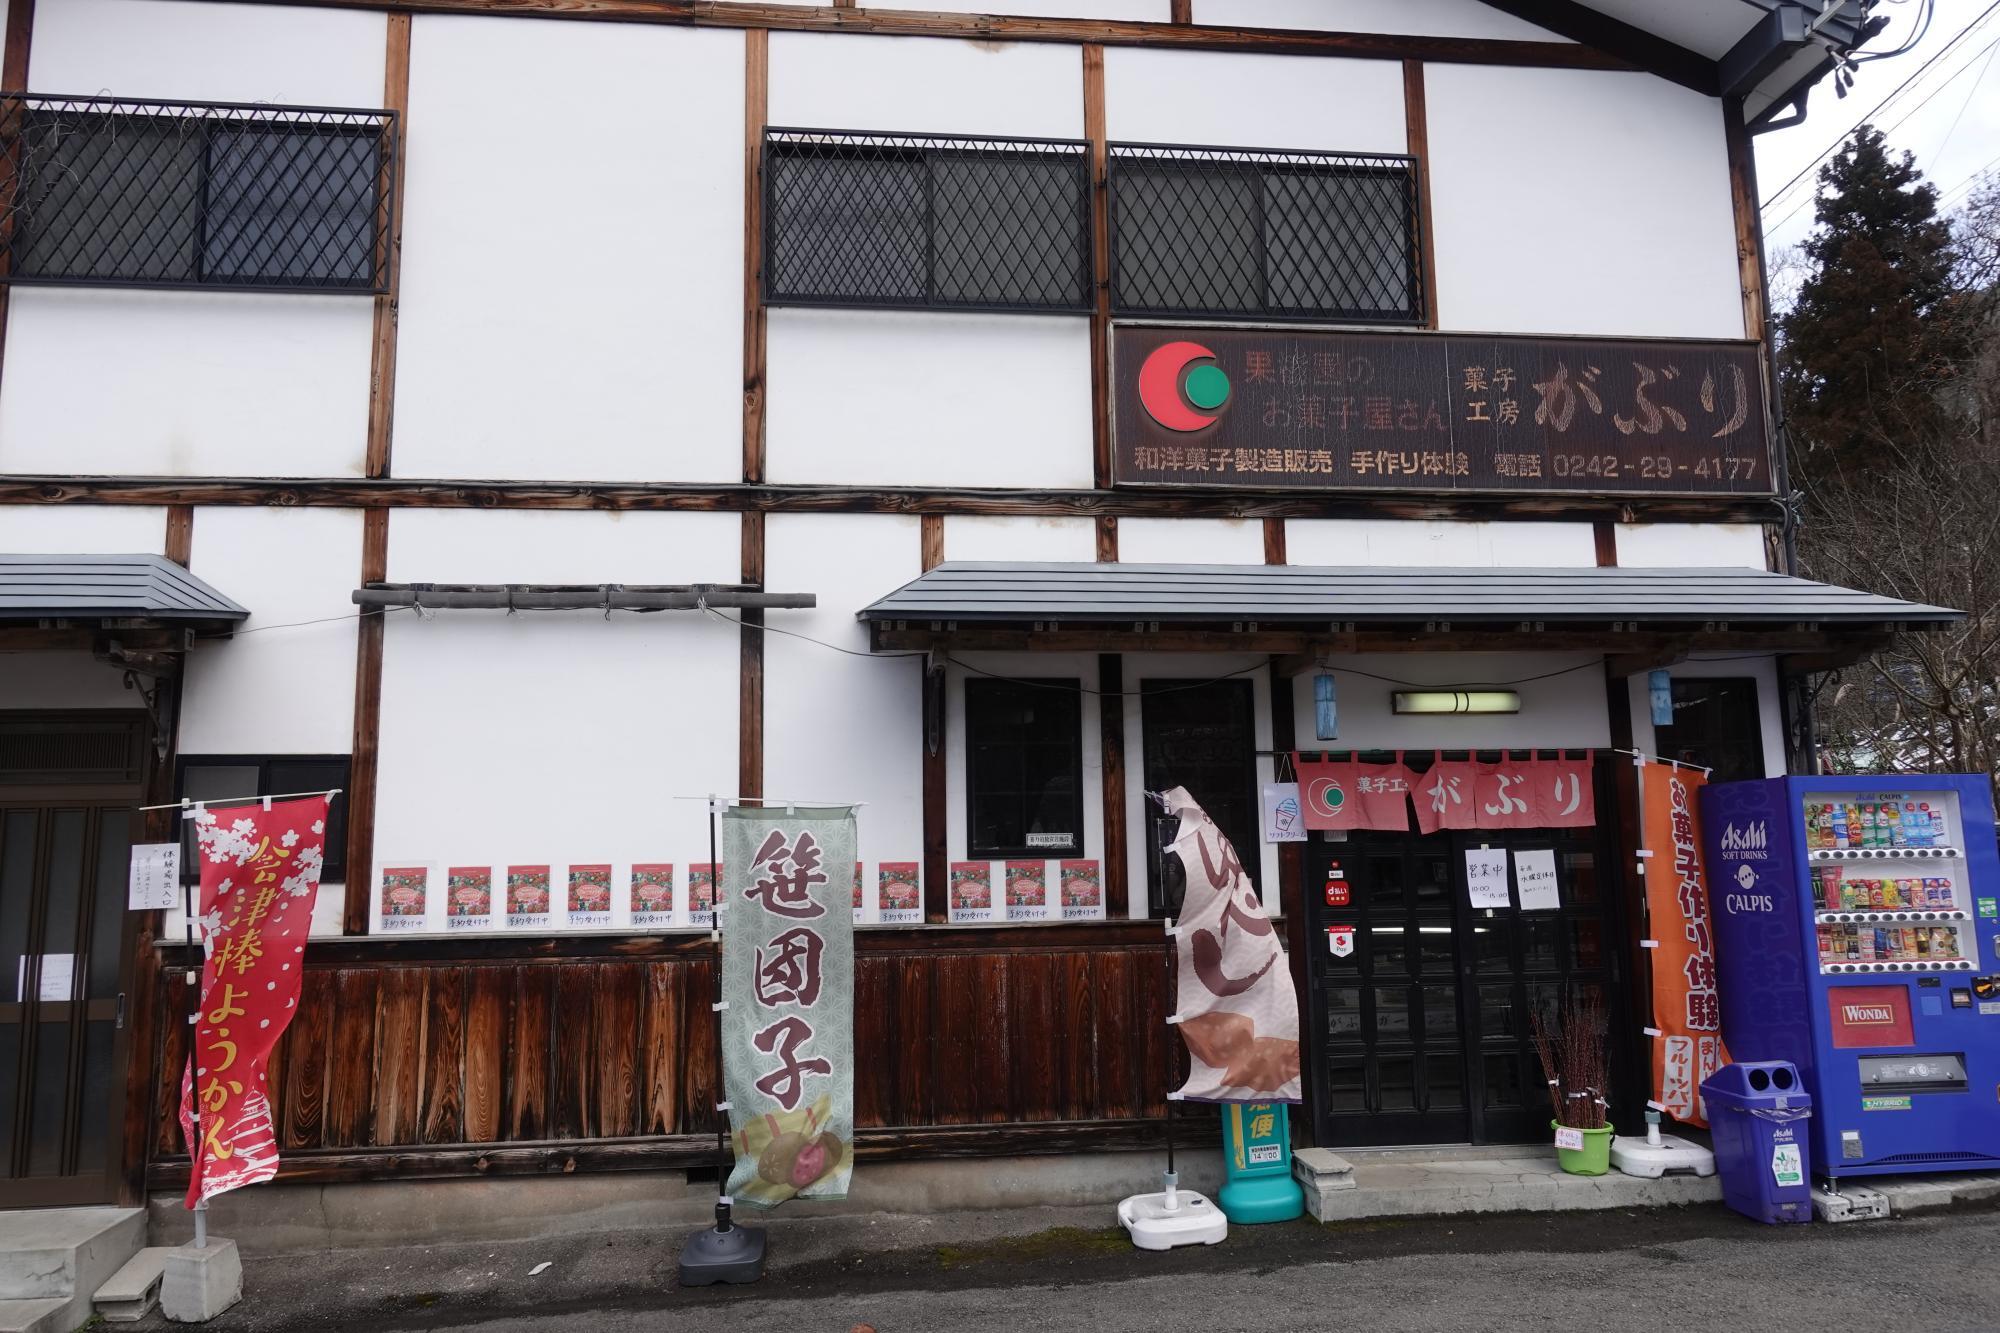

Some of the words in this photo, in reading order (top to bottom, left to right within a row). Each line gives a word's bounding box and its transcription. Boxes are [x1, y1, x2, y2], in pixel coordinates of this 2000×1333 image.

[1532, 357, 1748, 438] がぶり
[1263, 397, 1449, 431] お菓子屋さん
[1134, 447, 1332, 473] 和洋菓子製造販売
[1351, 451, 1469, 475] 手作り体験
[1494, 453, 1541, 477] 電話
[1554, 455, 1756, 480] 0242-29-4177
[1427, 773, 1581, 816] がぶり
[1721, 820, 1767, 850] Asahi
[1722, 851, 1738, 860] SOFT
[1740, 850, 1767, 860] DRINKS
[1469, 863, 1503, 878] 営業中
[1521, 872, 1554, 882] 水曜定休日
[1670, 778, 1720, 1031] お菓子作り体験
[1726, 894, 1773, 914] CALPIS
[881, 912, 920, 922] 予約受付中
[954, 911, 991, 920] 予約受付中
[1008, 909, 1048, 919] 予約受付中
[1063, 908, 1099, 918] 予約受付中
[383, 918, 423, 928] 予約受付中
[449, 918, 489, 928] 予約受付中
[509, 917, 548, 927] 予約受付中
[569, 914, 610, 926] 予約受付中
[633, 914, 672, 926] 予約受付中
[743, 829, 832, 1113] 笹団子
[200, 836, 290, 1160] 会津棒ようかん
[1845, 1005, 1889, 1022] WONDA
[1773, 1128, 1793, 1138] Asahi
